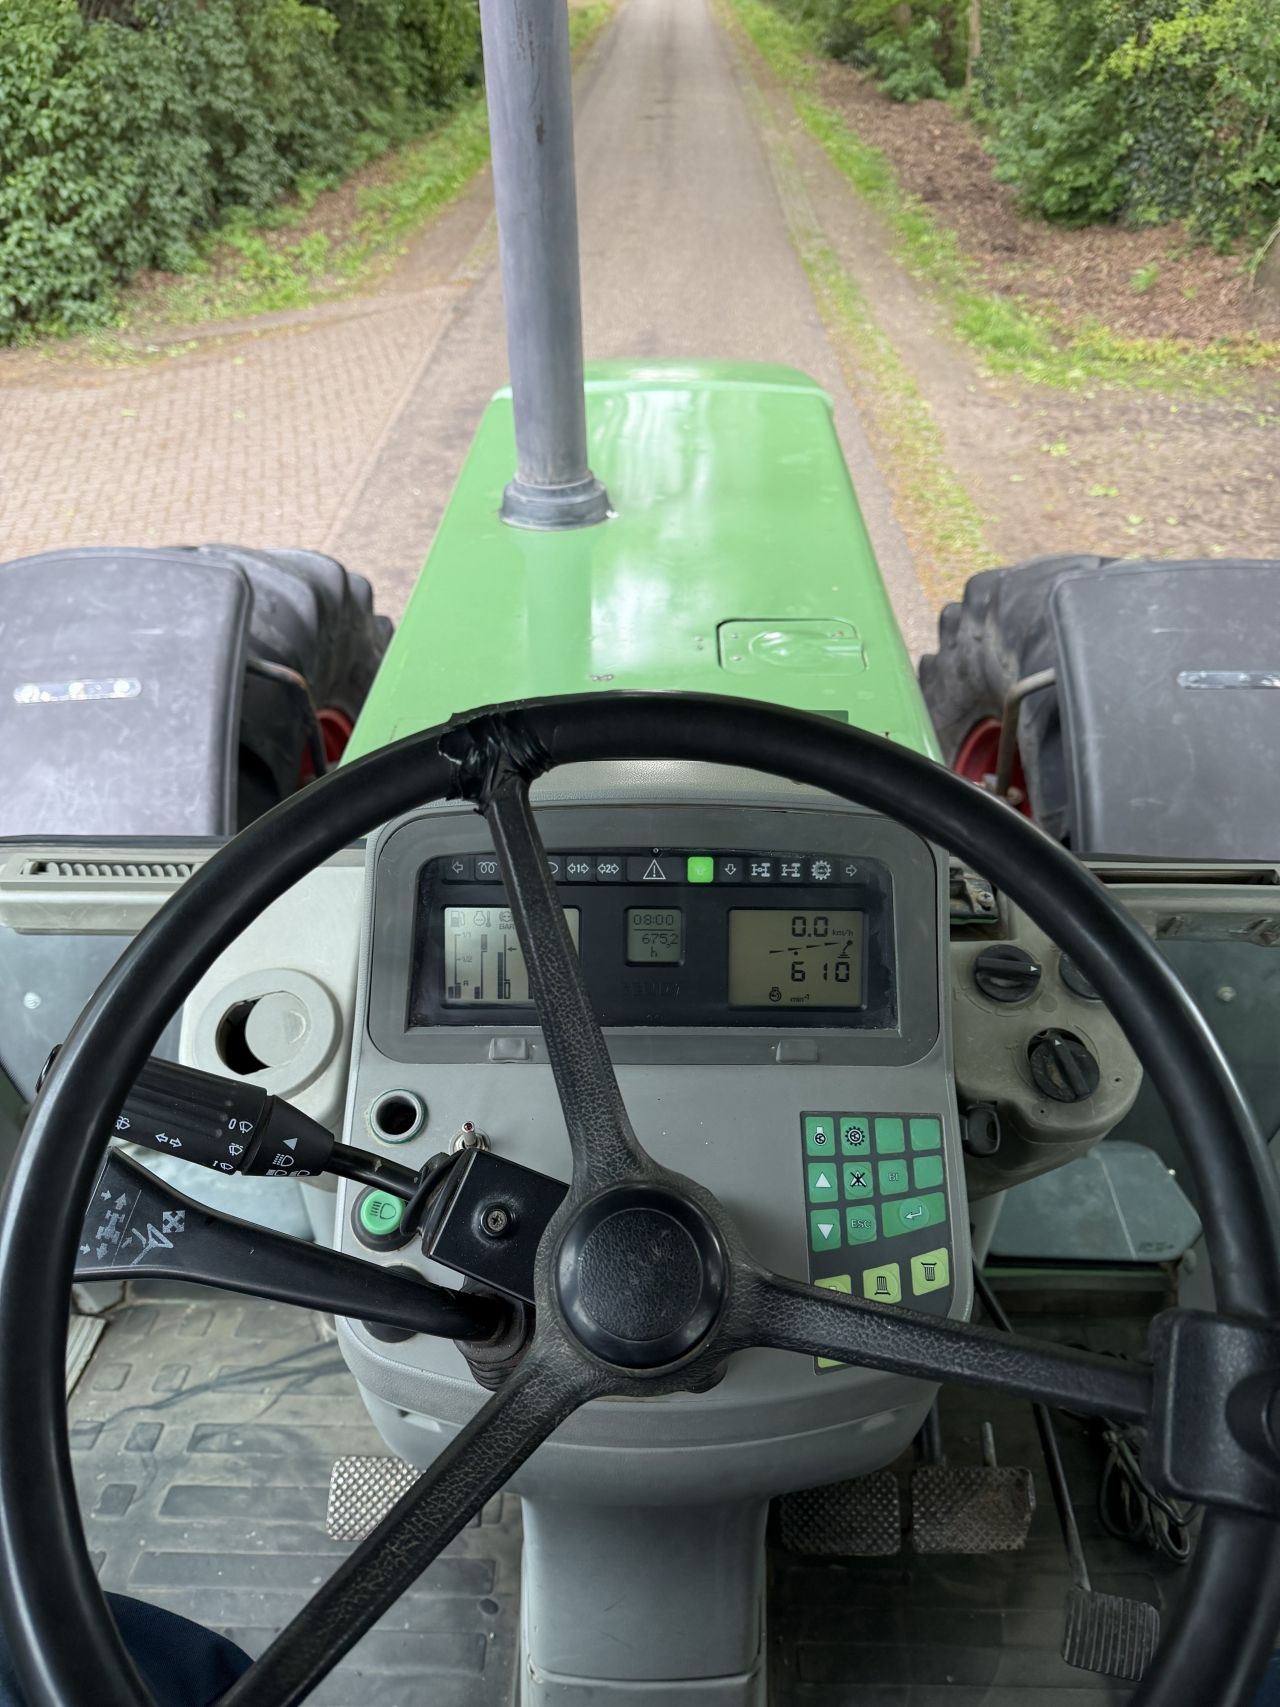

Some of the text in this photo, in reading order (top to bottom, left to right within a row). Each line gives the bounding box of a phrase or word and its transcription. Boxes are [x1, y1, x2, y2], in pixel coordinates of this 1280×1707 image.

[576, 864, 580, 873] 1
[606, 864, 611, 873] 2
[633, 914, 674, 926] 08:00
[791, 916, 854, 937] 0.0 km/h
[650, 946, 658, 958] h
[228, 1119, 236, 1130] 0
[851, 1220, 871, 1229] ESC
